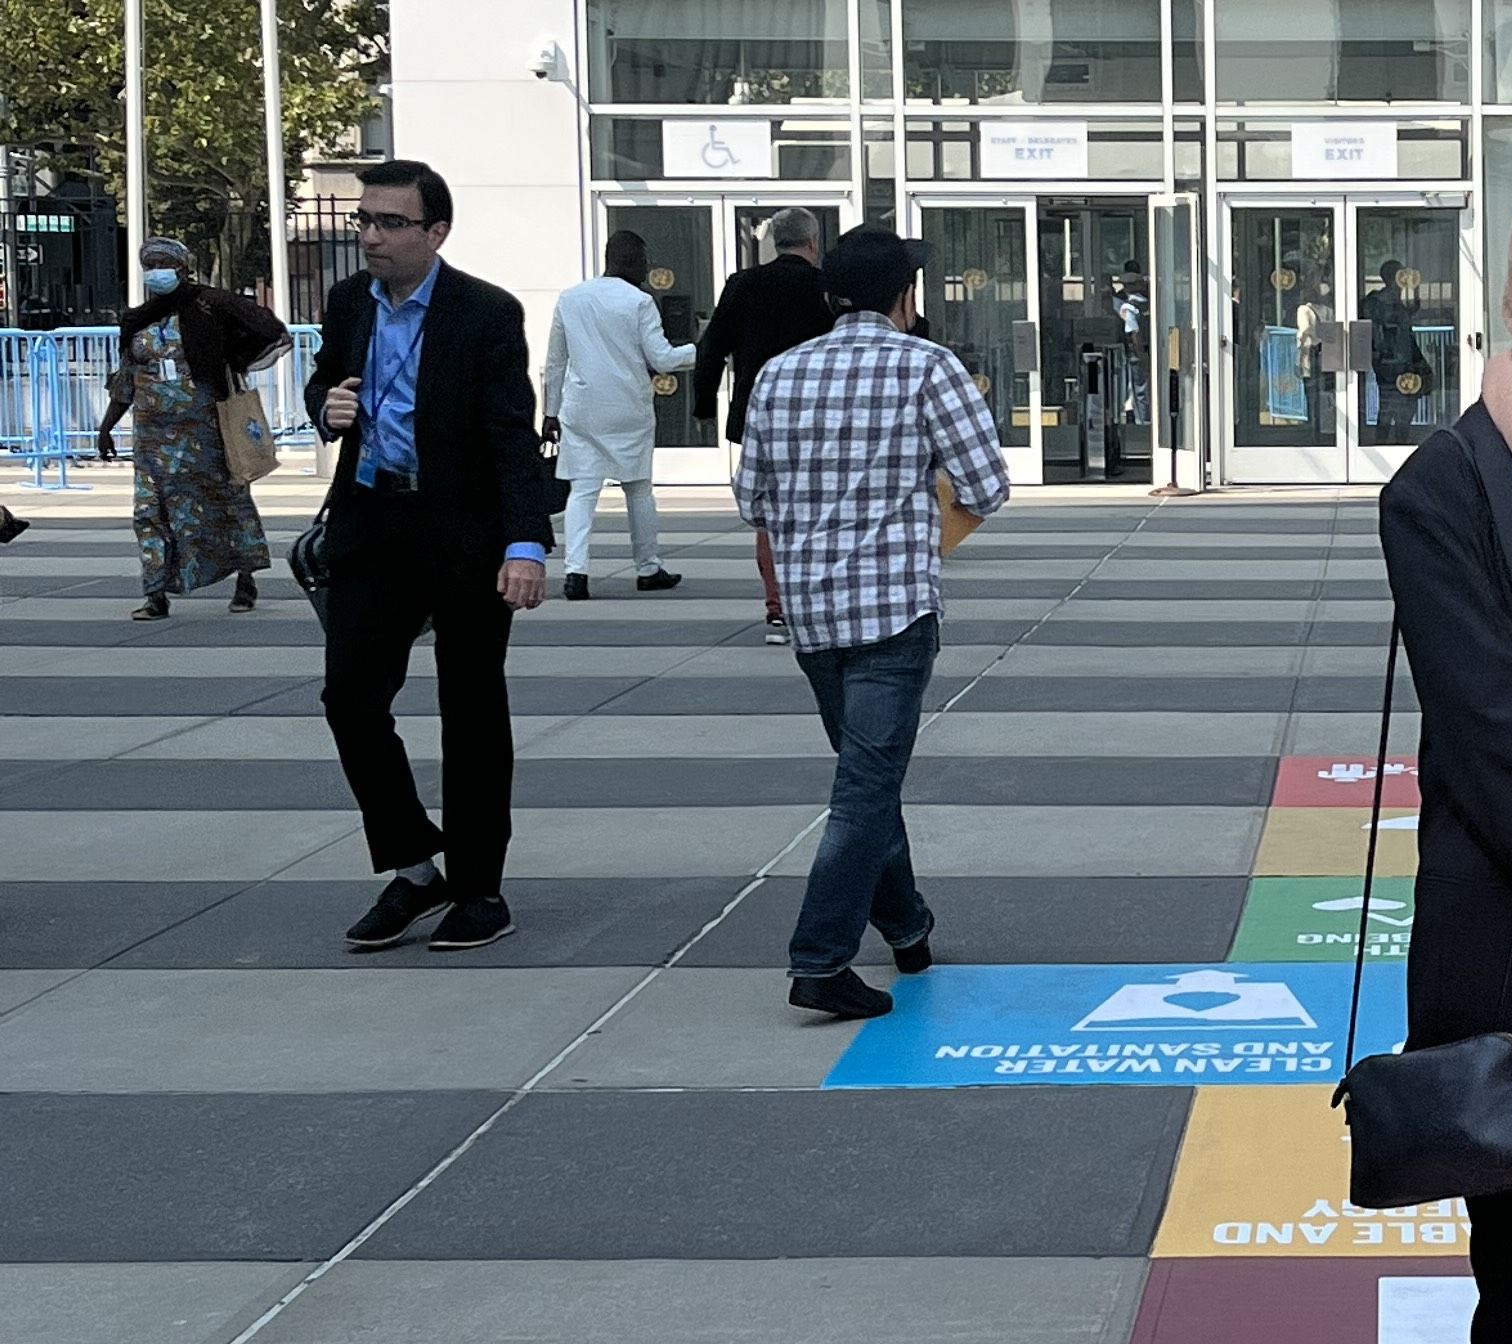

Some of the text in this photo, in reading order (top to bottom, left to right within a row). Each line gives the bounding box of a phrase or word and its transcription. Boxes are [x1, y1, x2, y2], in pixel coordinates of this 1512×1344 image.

[1015, 147, 1054, 160] EXIT
[1324, 148, 1364, 161] EXIT
[934, 1041, 1335, 1058] AND SANITATION
[994, 1057, 1333, 1075] CLEAN WATER
[1212, 1221, 1340, 1244] AND
